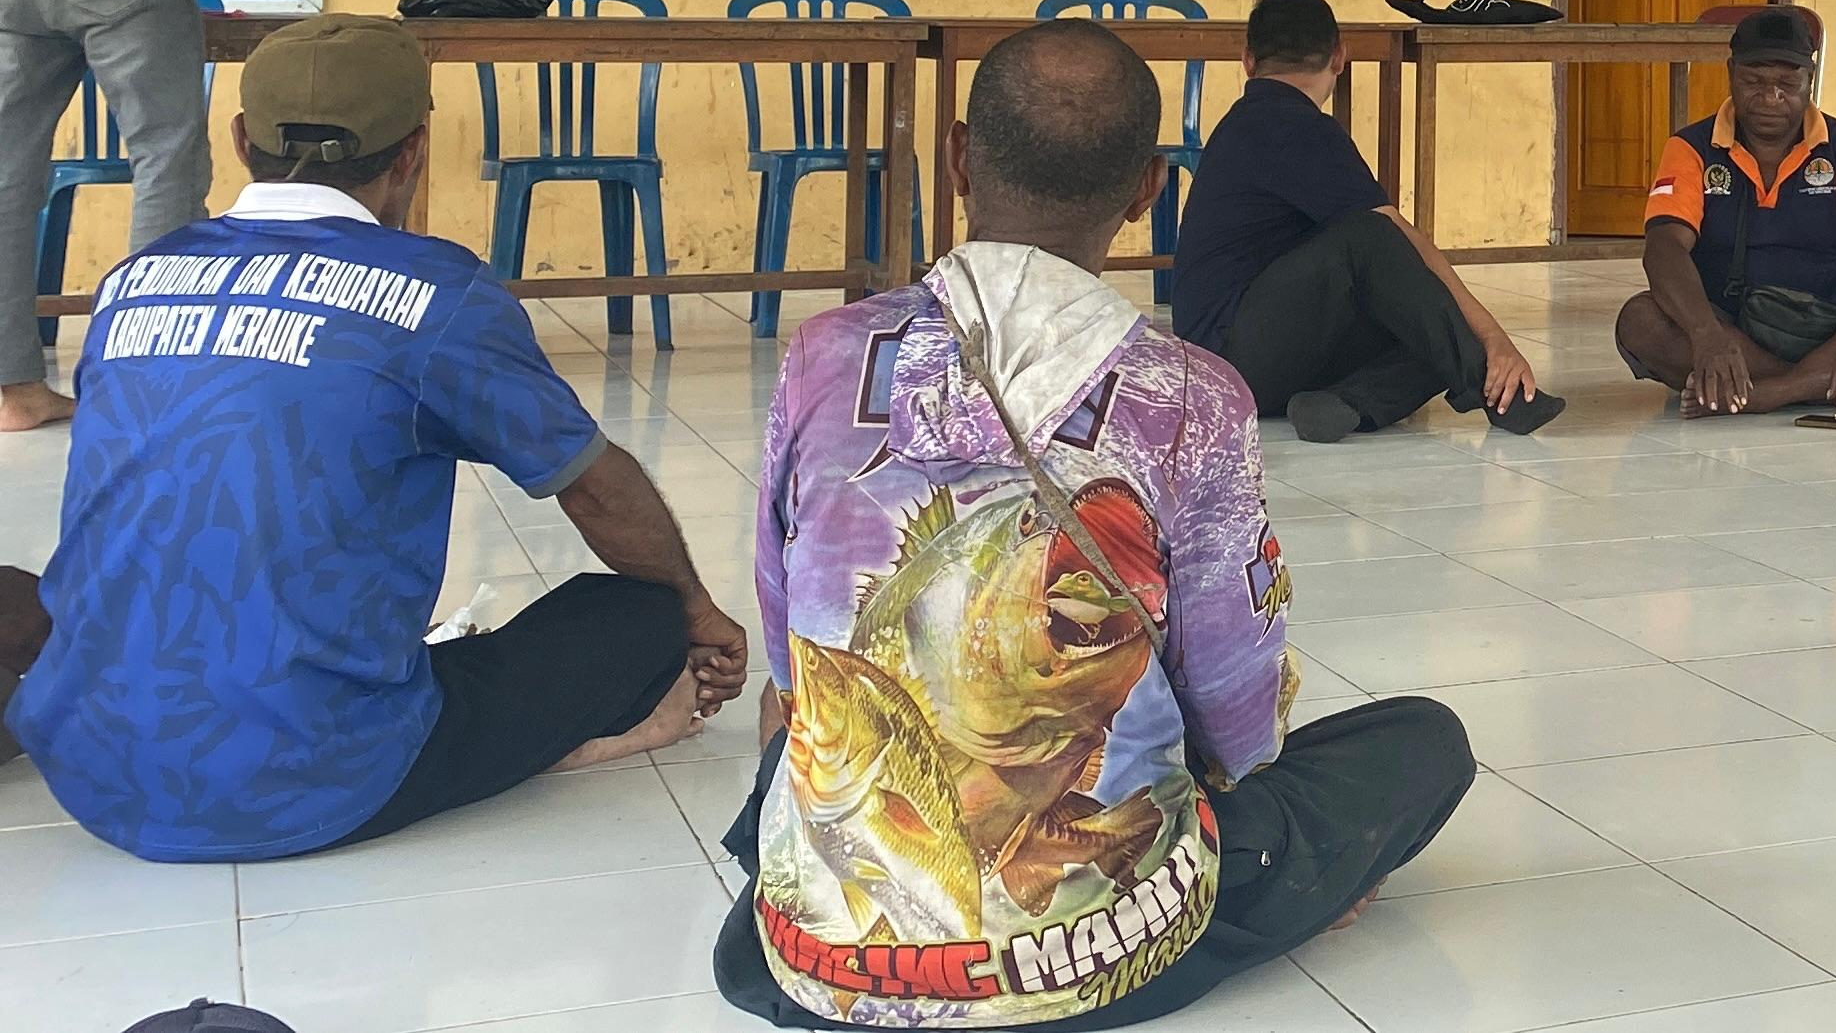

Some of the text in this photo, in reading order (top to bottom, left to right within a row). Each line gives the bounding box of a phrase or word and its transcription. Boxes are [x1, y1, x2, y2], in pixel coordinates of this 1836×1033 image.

[117, 255, 243, 301] PENDIDIKAN
[228, 253, 291, 296] DAN
[281, 252, 437, 332] KEBUDAYAAN
[103, 305, 327, 368] KABUPATEN MERAUKE
